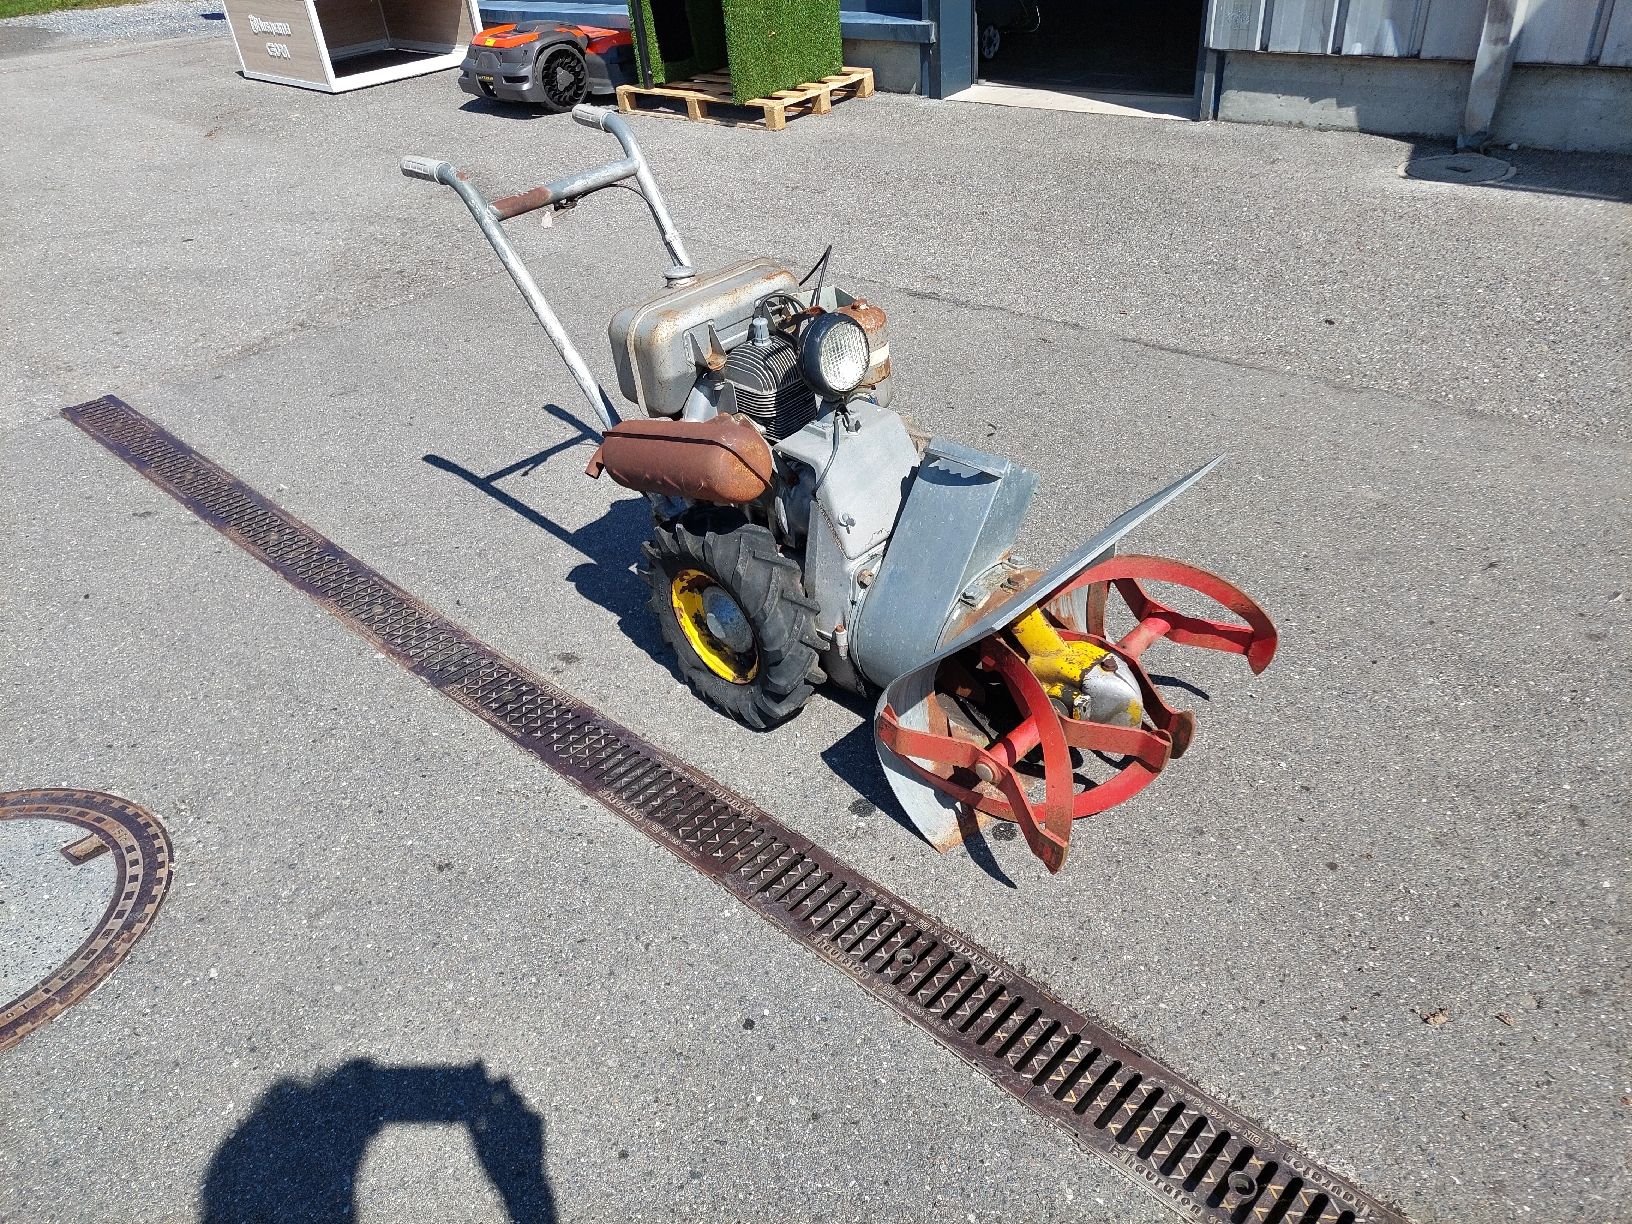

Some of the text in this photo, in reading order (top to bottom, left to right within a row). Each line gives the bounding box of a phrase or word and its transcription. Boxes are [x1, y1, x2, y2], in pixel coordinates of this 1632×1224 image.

[1242, 1129, 1264, 1147] DIN
[1124, 1153, 1202, 1215] hauraton
[1283, 1152, 1370, 1215] hauraton
